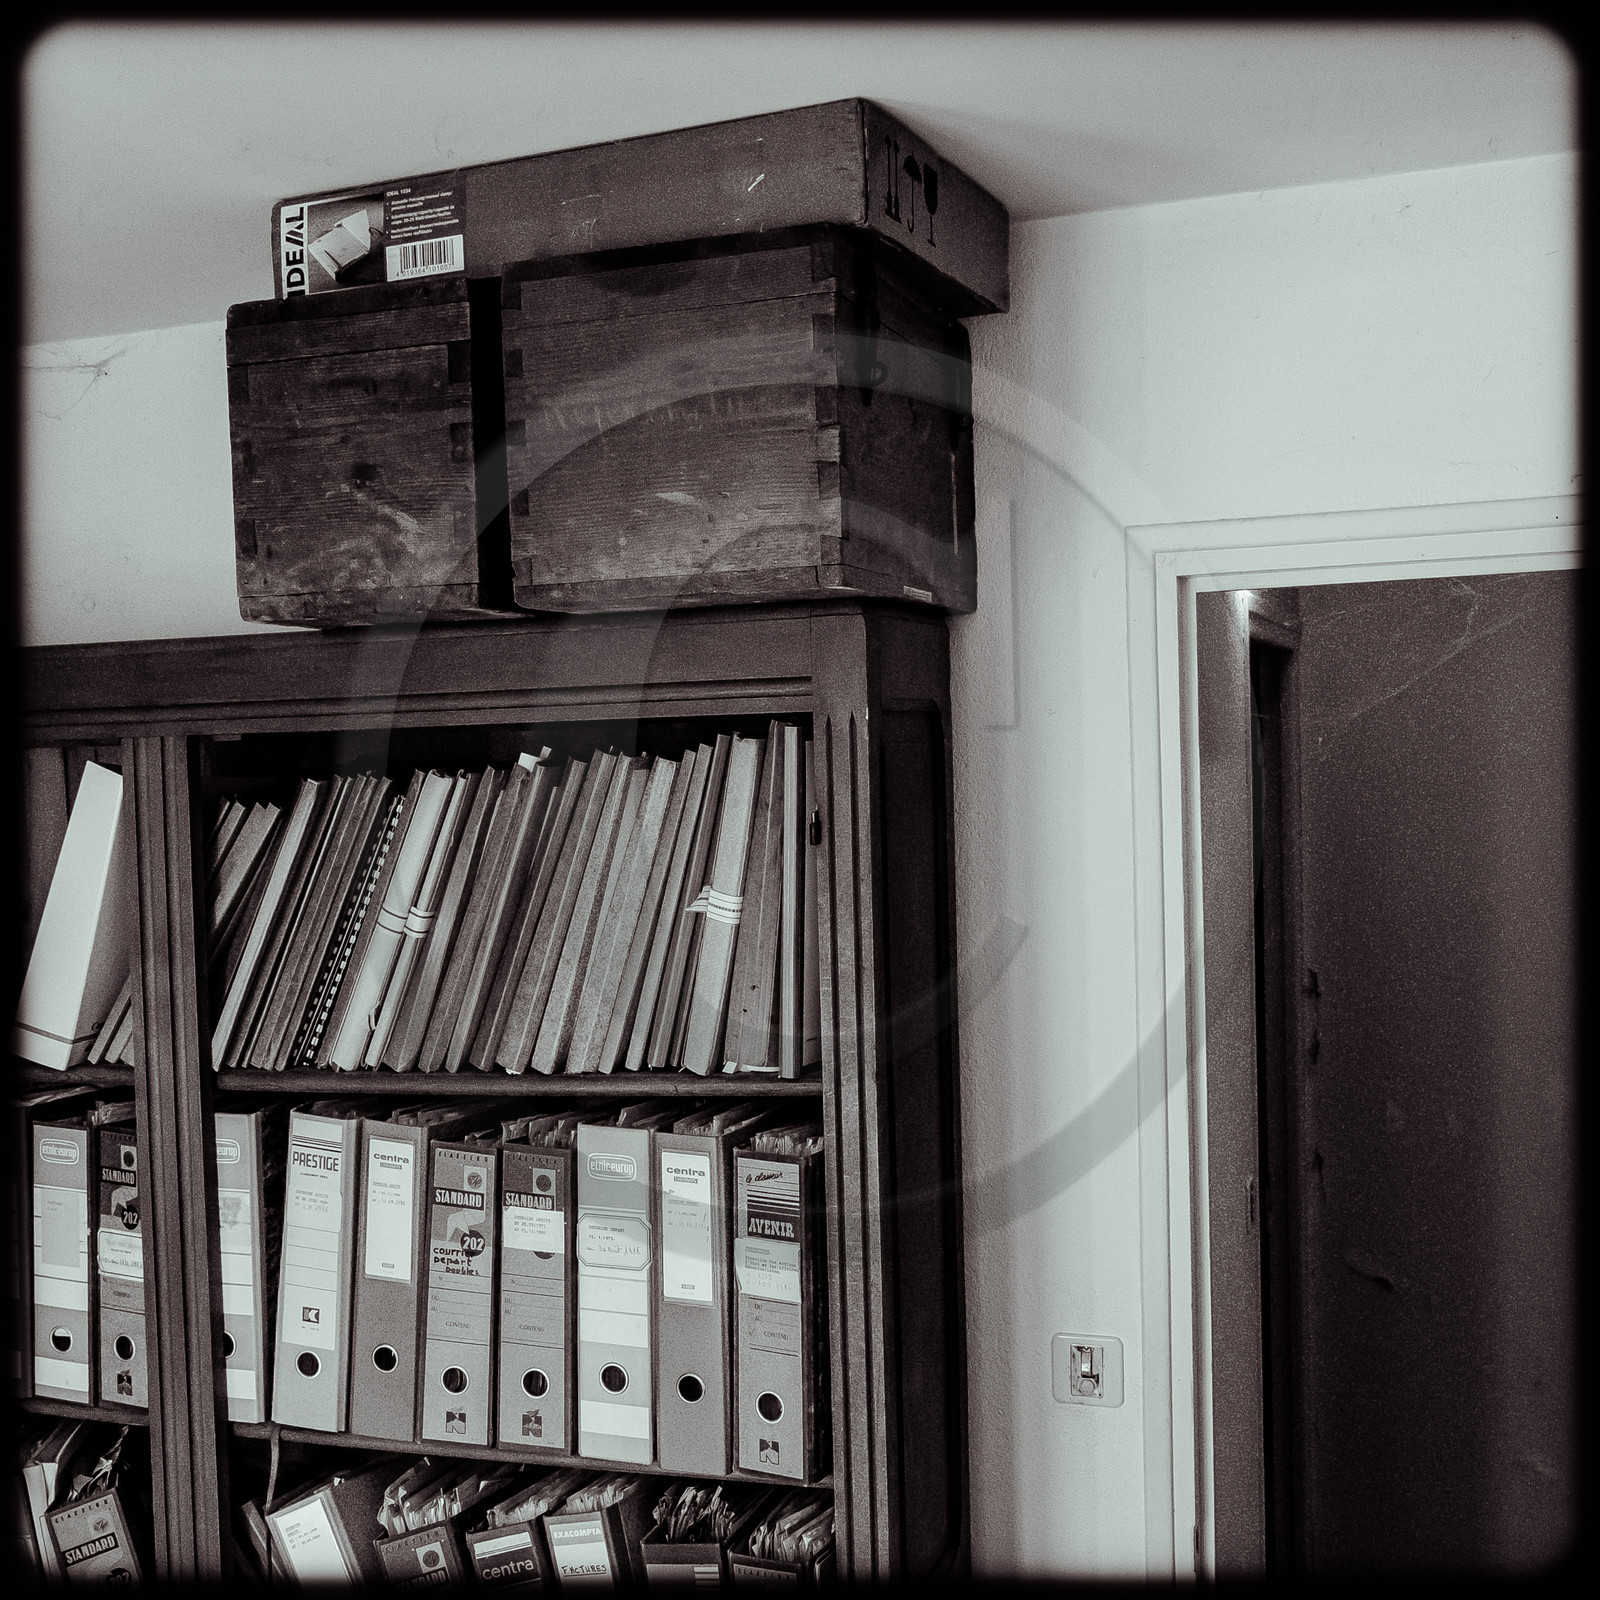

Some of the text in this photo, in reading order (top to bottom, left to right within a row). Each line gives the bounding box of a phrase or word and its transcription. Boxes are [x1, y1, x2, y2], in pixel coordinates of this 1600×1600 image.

[285, 206, 306, 297] IDEAL
[292, 1151, 340, 1172] PRESTIGE
[373, 1152, 410, 1164] centra
[102, 1168, 136, 1185] STANDARD
[666, 1166, 706, 1177] centra
[435, 1188, 482, 1208] STANDARD
[505, 1192, 553, 1210] STANDARD
[123, 1211, 138, 1225] 202
[748, 1217, 795, 1238] AVENIR
[462, 1236, 485, 1251] 202
[763, 1331, 789, 1341] CONTENU
[553, 1527, 602, 1539] EXACOMPTA
[64, 1535, 116, 1564] STANDARD
[482, 1559, 535, 1580] centra
[561, 1564, 607, 1575] FACTURES
